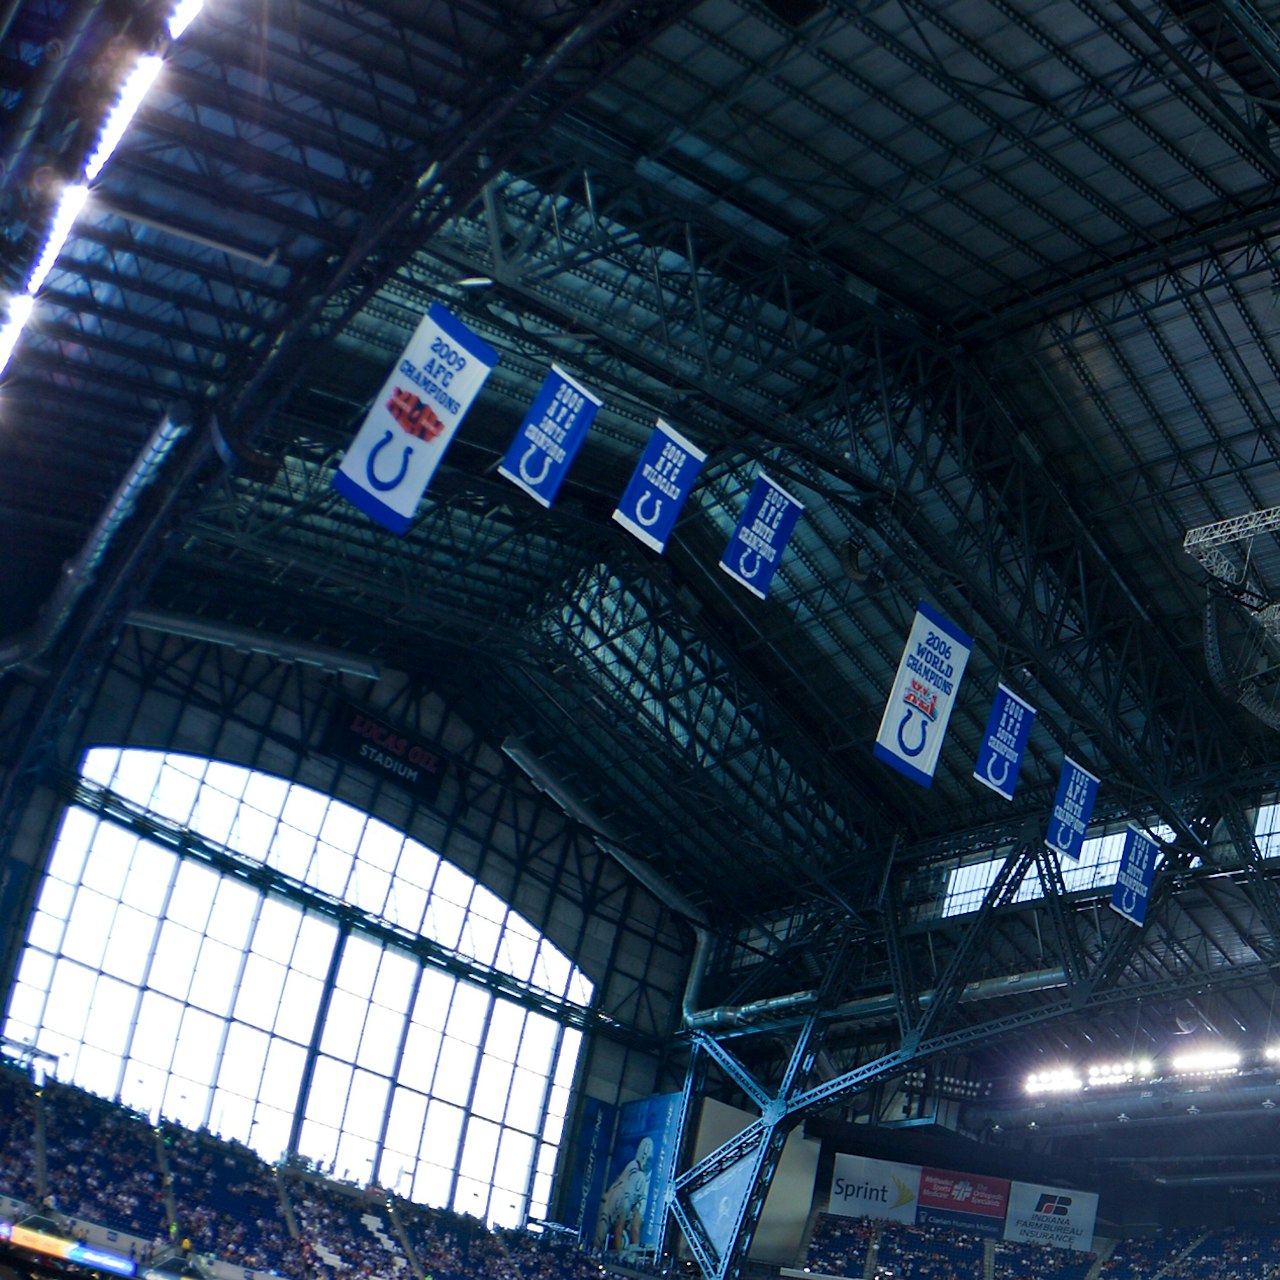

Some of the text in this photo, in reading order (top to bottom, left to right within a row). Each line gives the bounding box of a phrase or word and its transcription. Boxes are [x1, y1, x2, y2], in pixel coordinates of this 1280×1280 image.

[430, 337, 466, 372] 2009
[423, 357, 454, 388] AFC
[400, 360, 461, 416] CHAMPIONS
[546, 399, 576, 430] AFC
[655, 456, 680, 482] AFC
[765, 487, 789, 511] 2007
[757, 500, 783, 530] AFC
[916, 642, 954, 678] WORLD
[925, 631, 953, 660] 2006
[906, 654, 954, 696] CHAMPIONS
[360, 743, 419, 782] STADIUM
[1066, 781, 1087, 806] AFC
[834, 1178, 889, 1204] Sprint
[1030, 1213, 1071, 1226] INDIANA
[1018, 1229, 1075, 1244] INSURANCE
